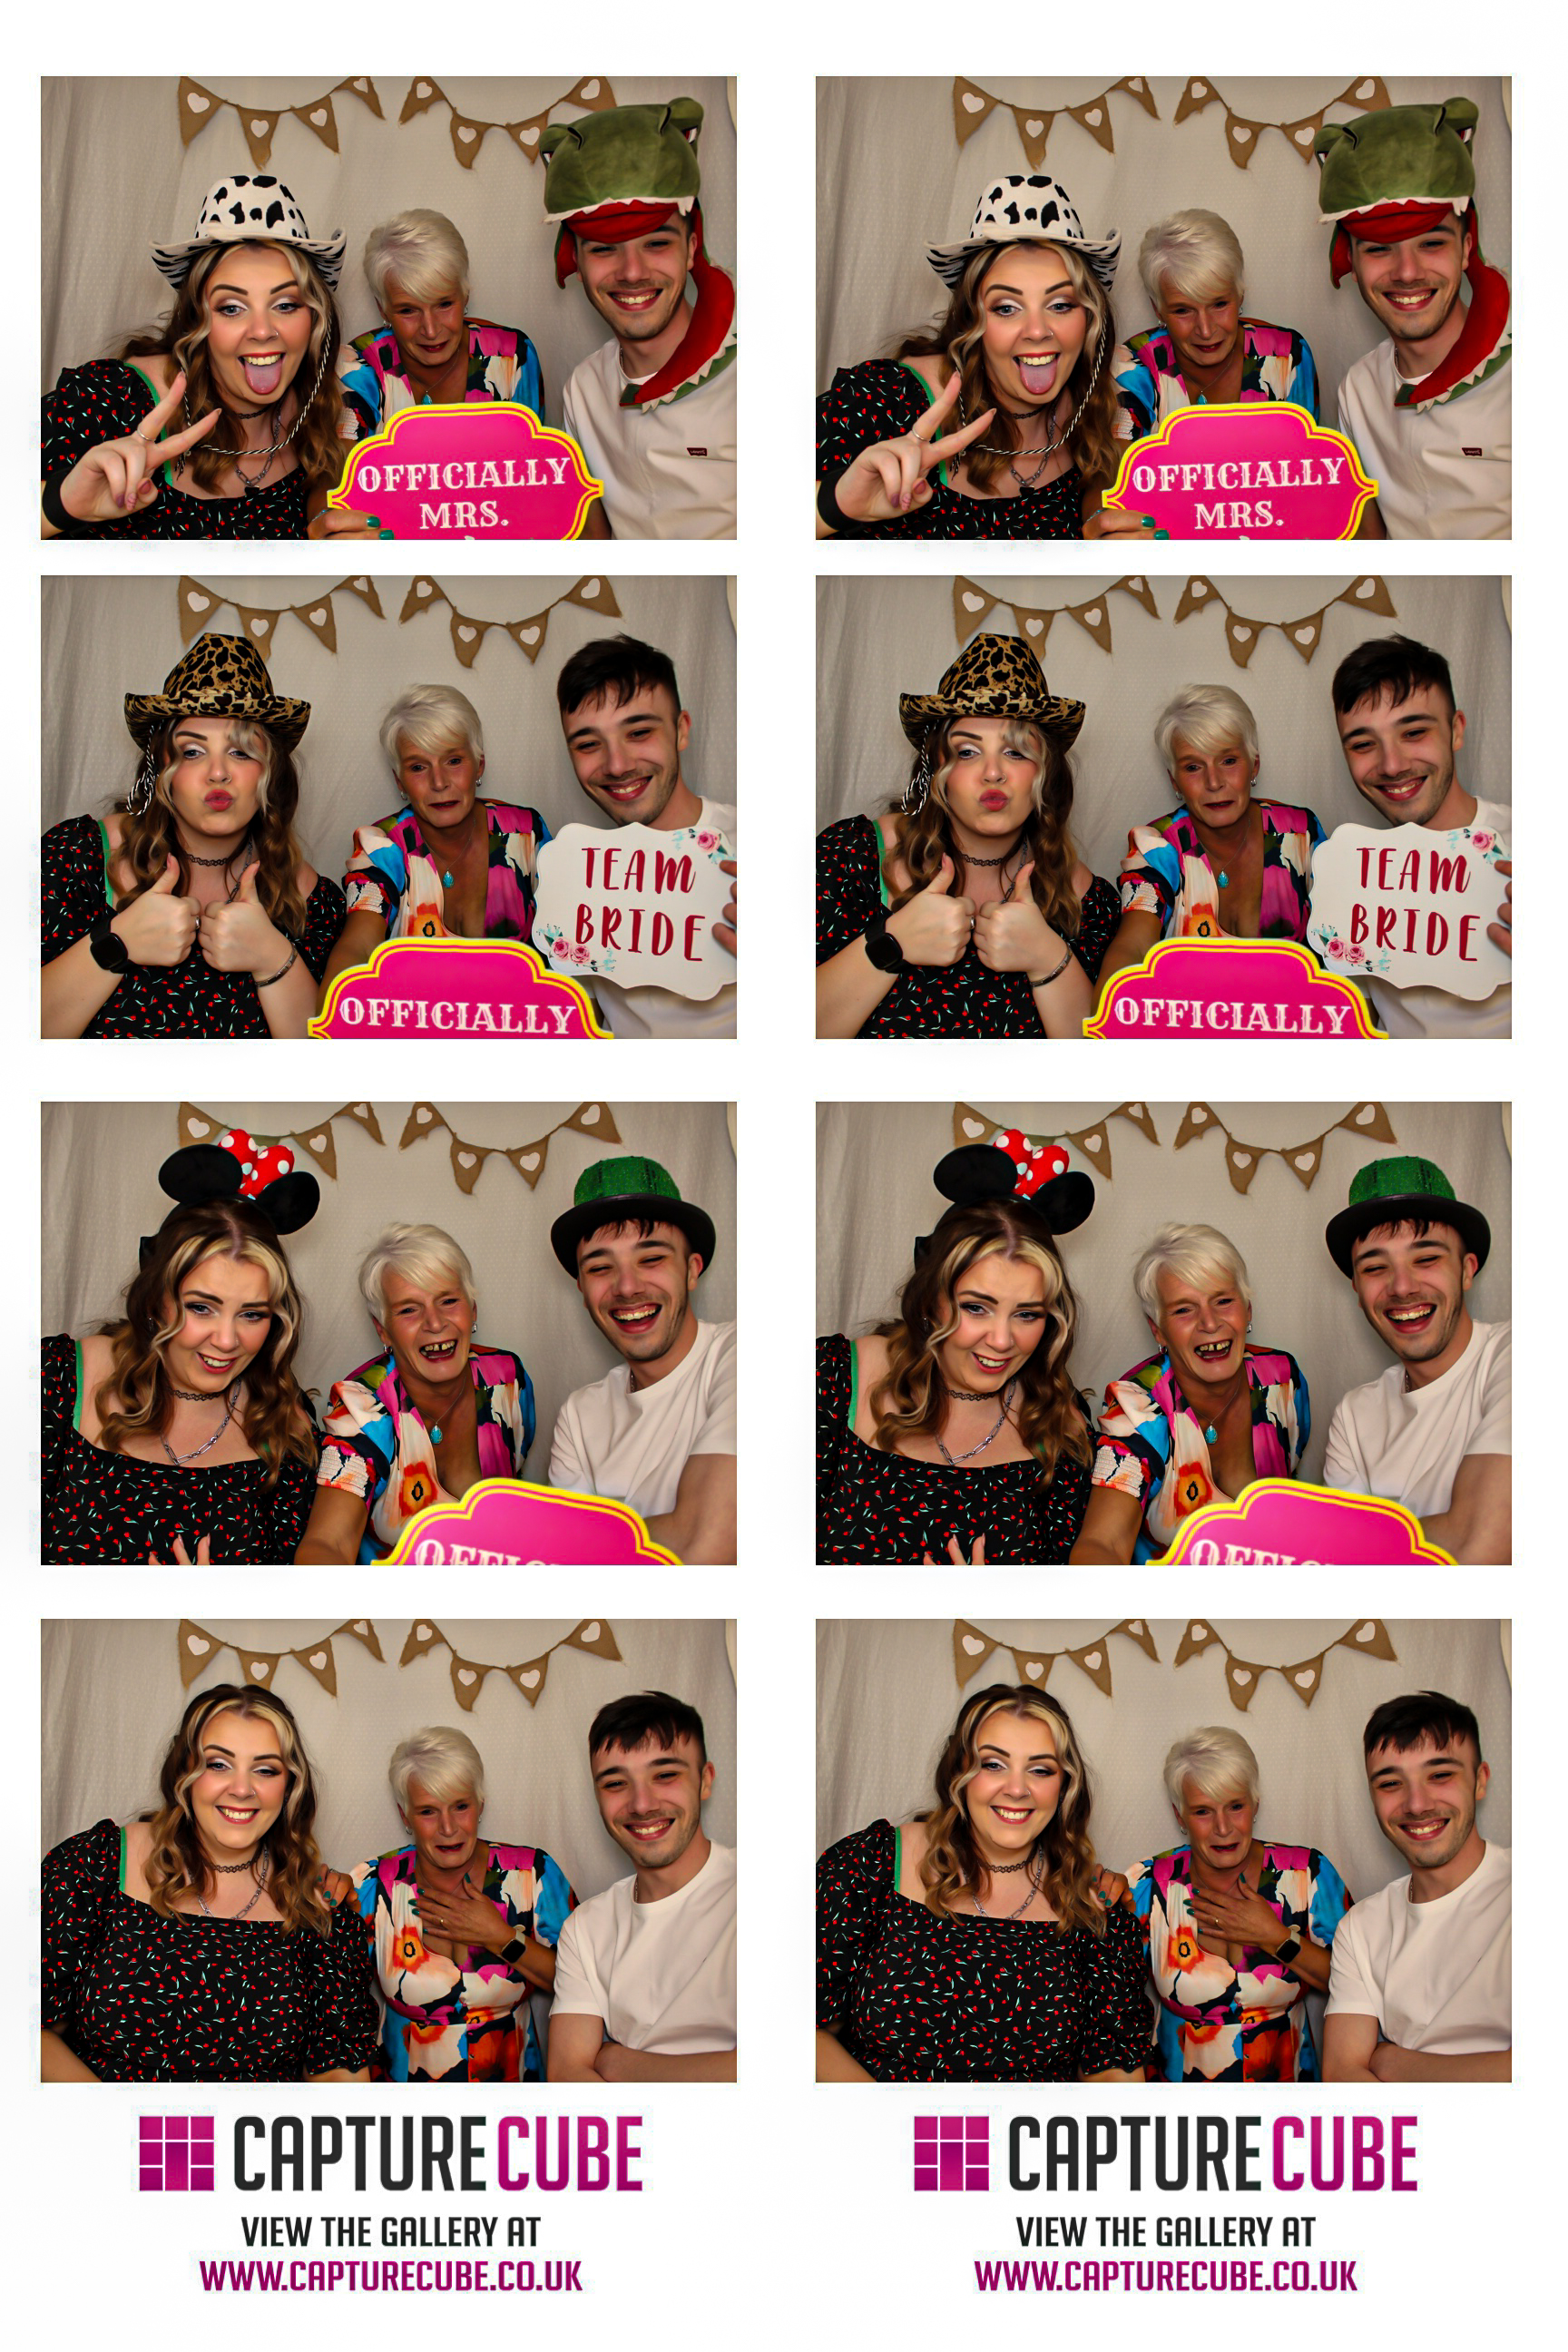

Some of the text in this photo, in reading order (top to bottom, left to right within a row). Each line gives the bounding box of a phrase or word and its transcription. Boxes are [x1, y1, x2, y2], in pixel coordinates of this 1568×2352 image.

[357, 456, 571, 493] OFFICIALLY
[1132, 456, 1346, 493] OFFICIALLY
[418, 500, 509, 530] MRS.
[1193, 500, 1284, 530] MRS.
[581, 847, 696, 895] TEAM
[1356, 847, 1471, 895] TEAM
[574, 903, 706, 962] BRIDE
[1349, 903, 1481, 962] BRIDE
[339, 996, 577, 1035] OFFICIALLY
[1114, 996, 1352, 1035] OFFICIALLY
